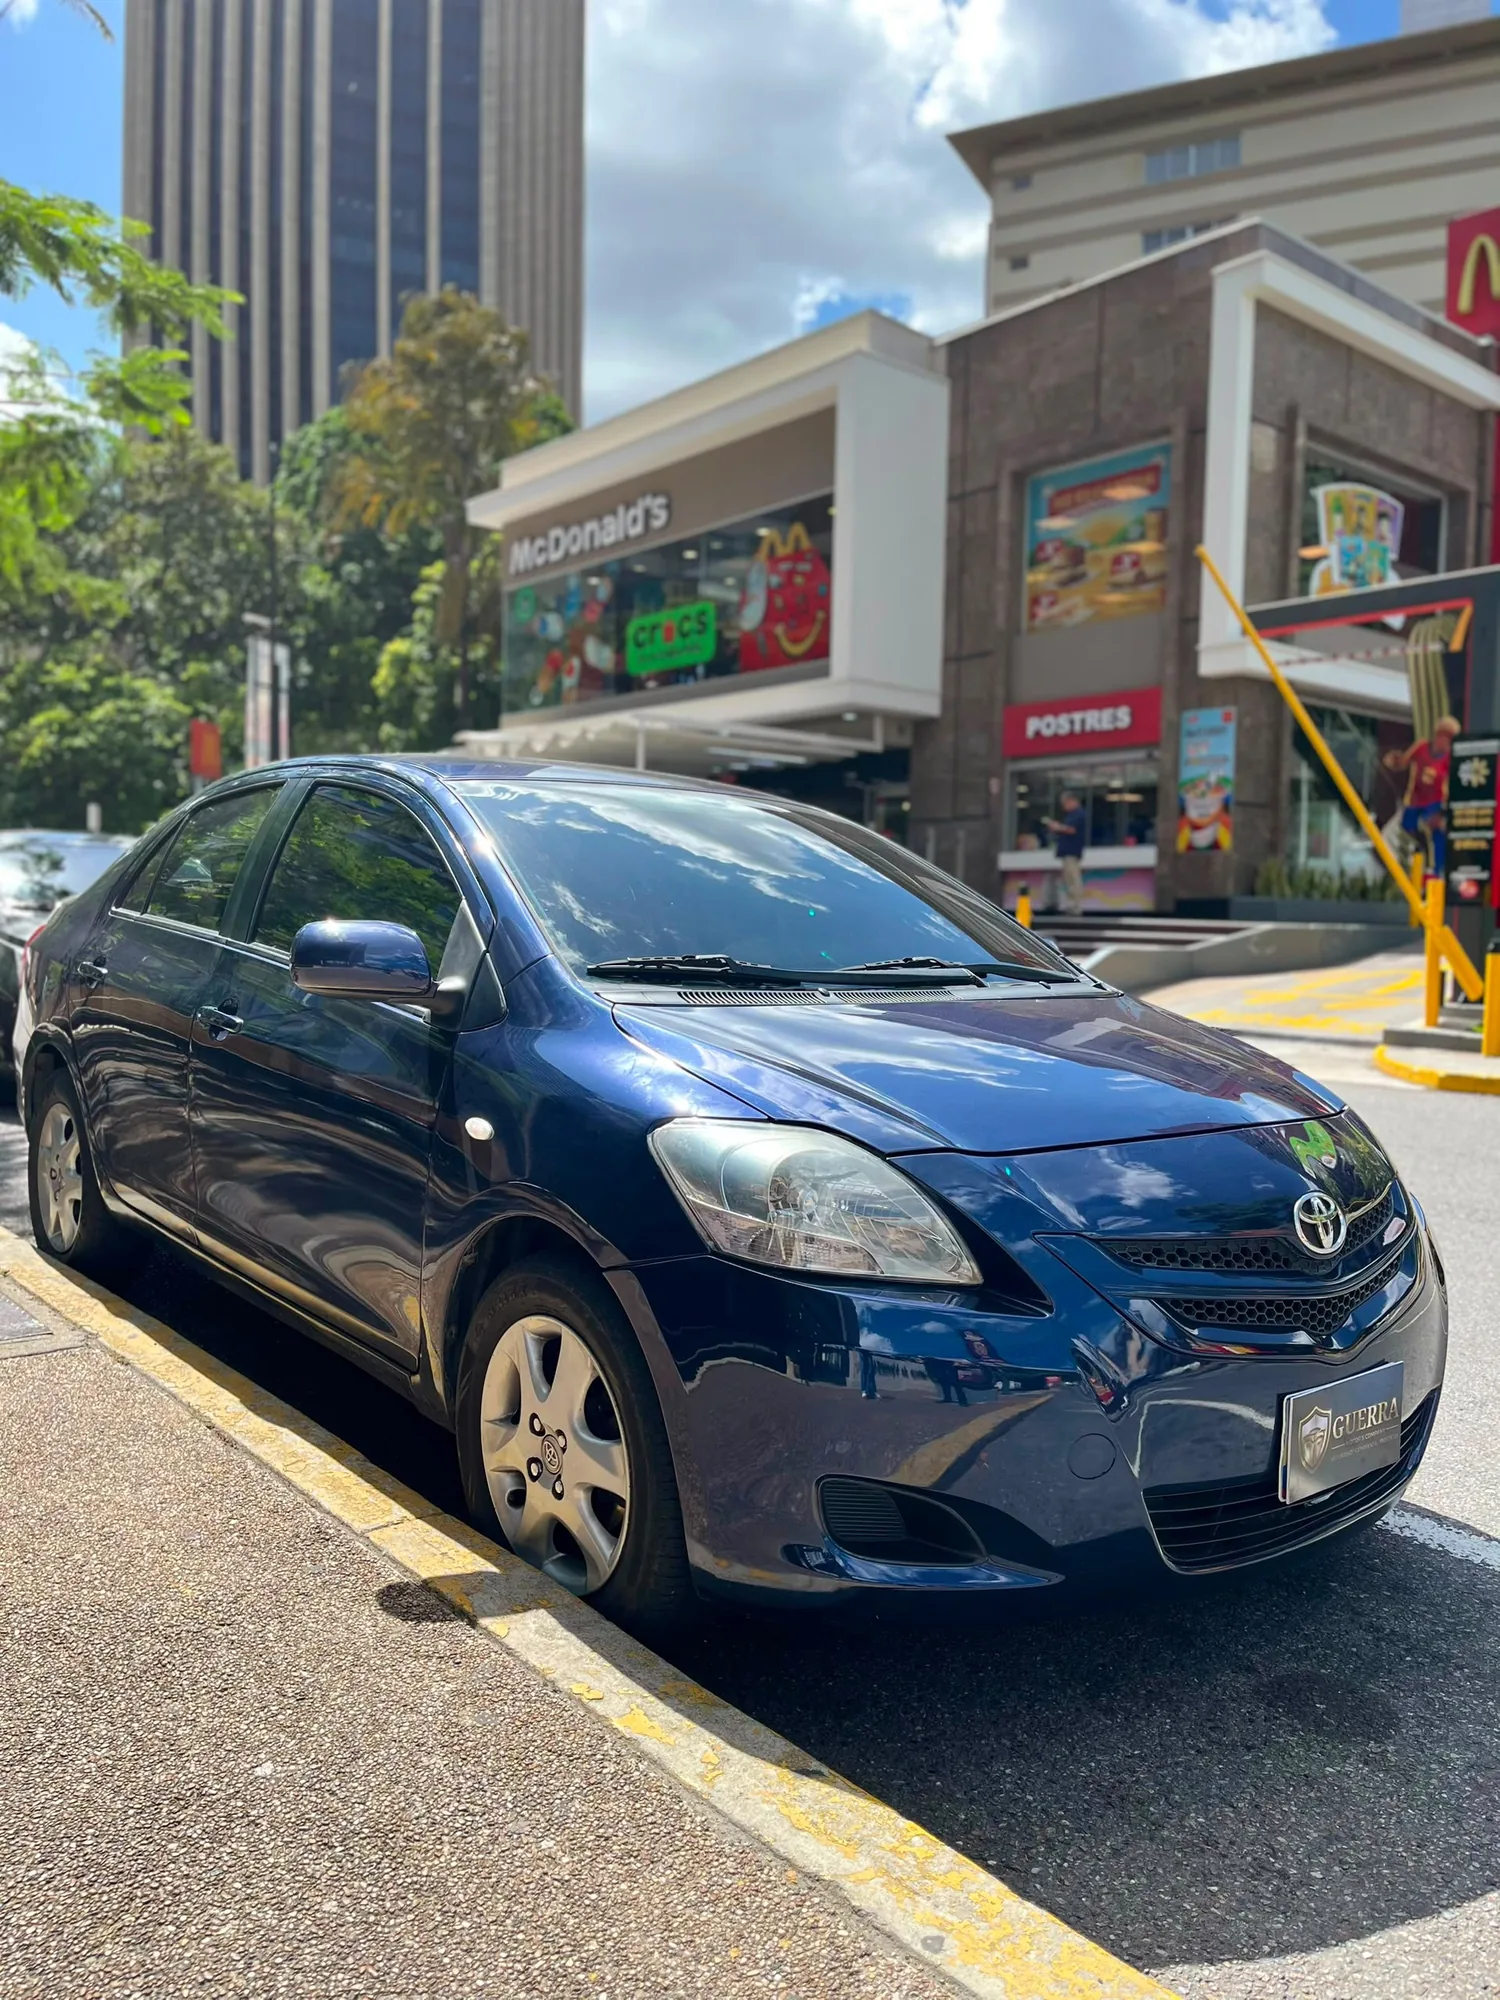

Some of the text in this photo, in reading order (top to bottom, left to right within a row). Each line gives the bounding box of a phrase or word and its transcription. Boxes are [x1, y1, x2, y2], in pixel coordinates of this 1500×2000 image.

[509, 493, 670, 575] McDonald's
[1025, 705, 1132, 740] POSTRES
[1332, 1397, 1399, 1439] GUERRA
